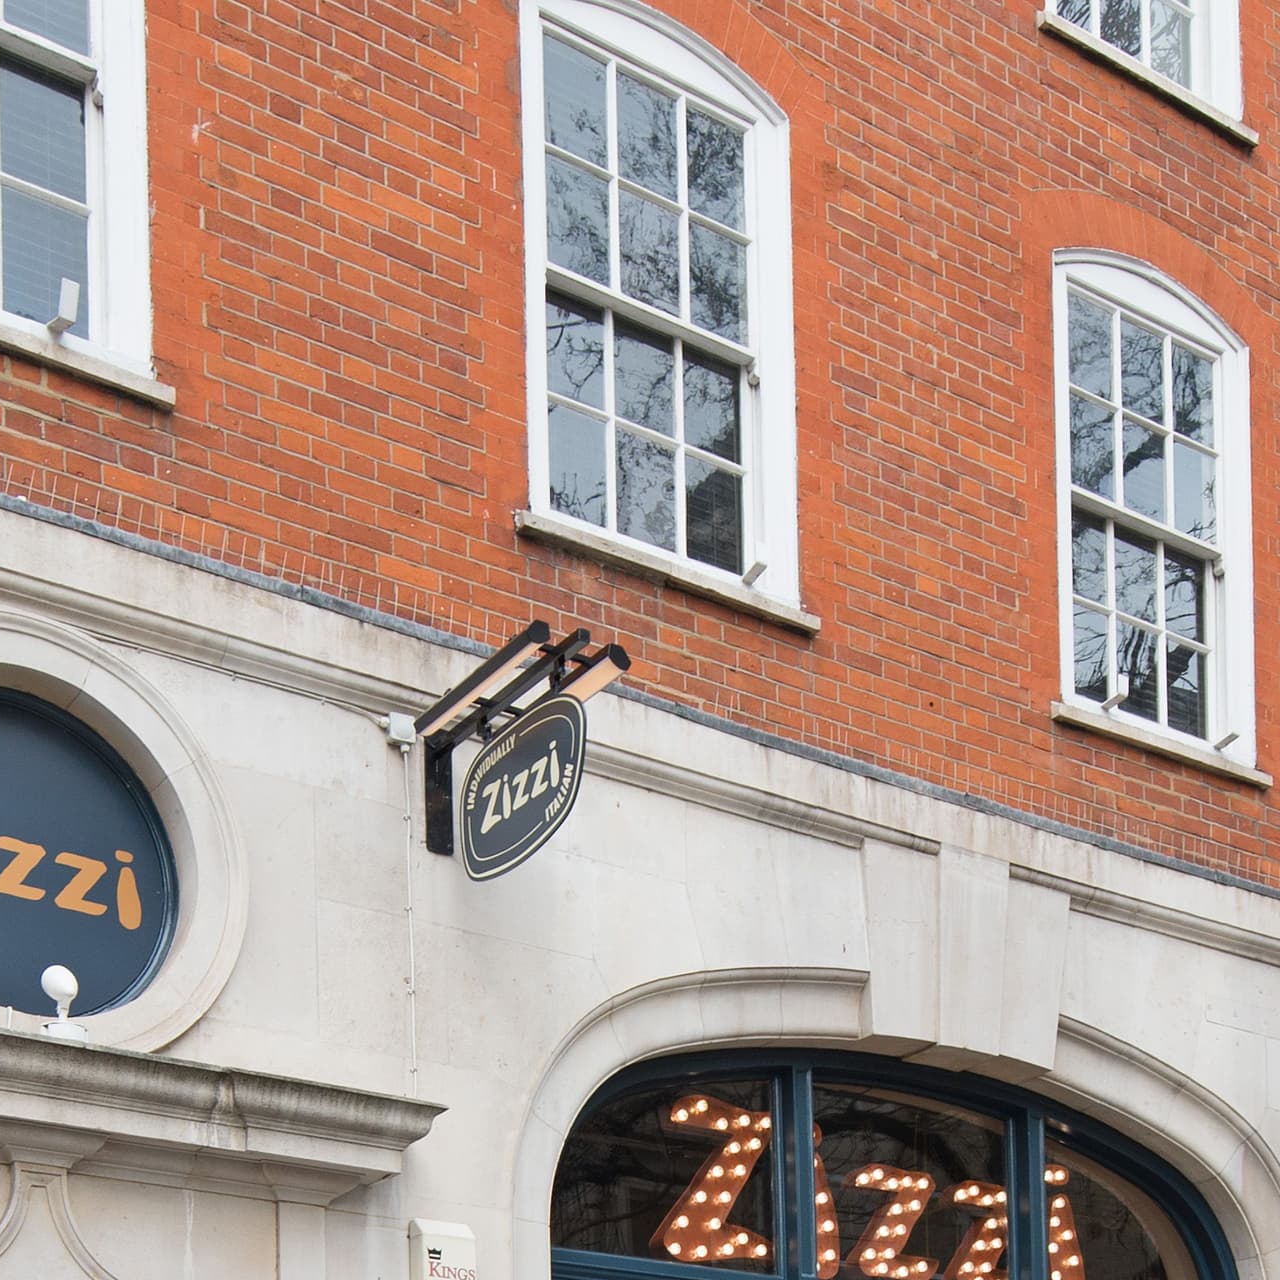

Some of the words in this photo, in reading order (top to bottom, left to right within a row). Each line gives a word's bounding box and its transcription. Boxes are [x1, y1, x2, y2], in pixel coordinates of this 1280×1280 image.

[467, 733, 517, 811] INDIVIDUALLY
[480, 740, 561, 835] Zizzi
[544, 763, 574, 822] ITALIAN
